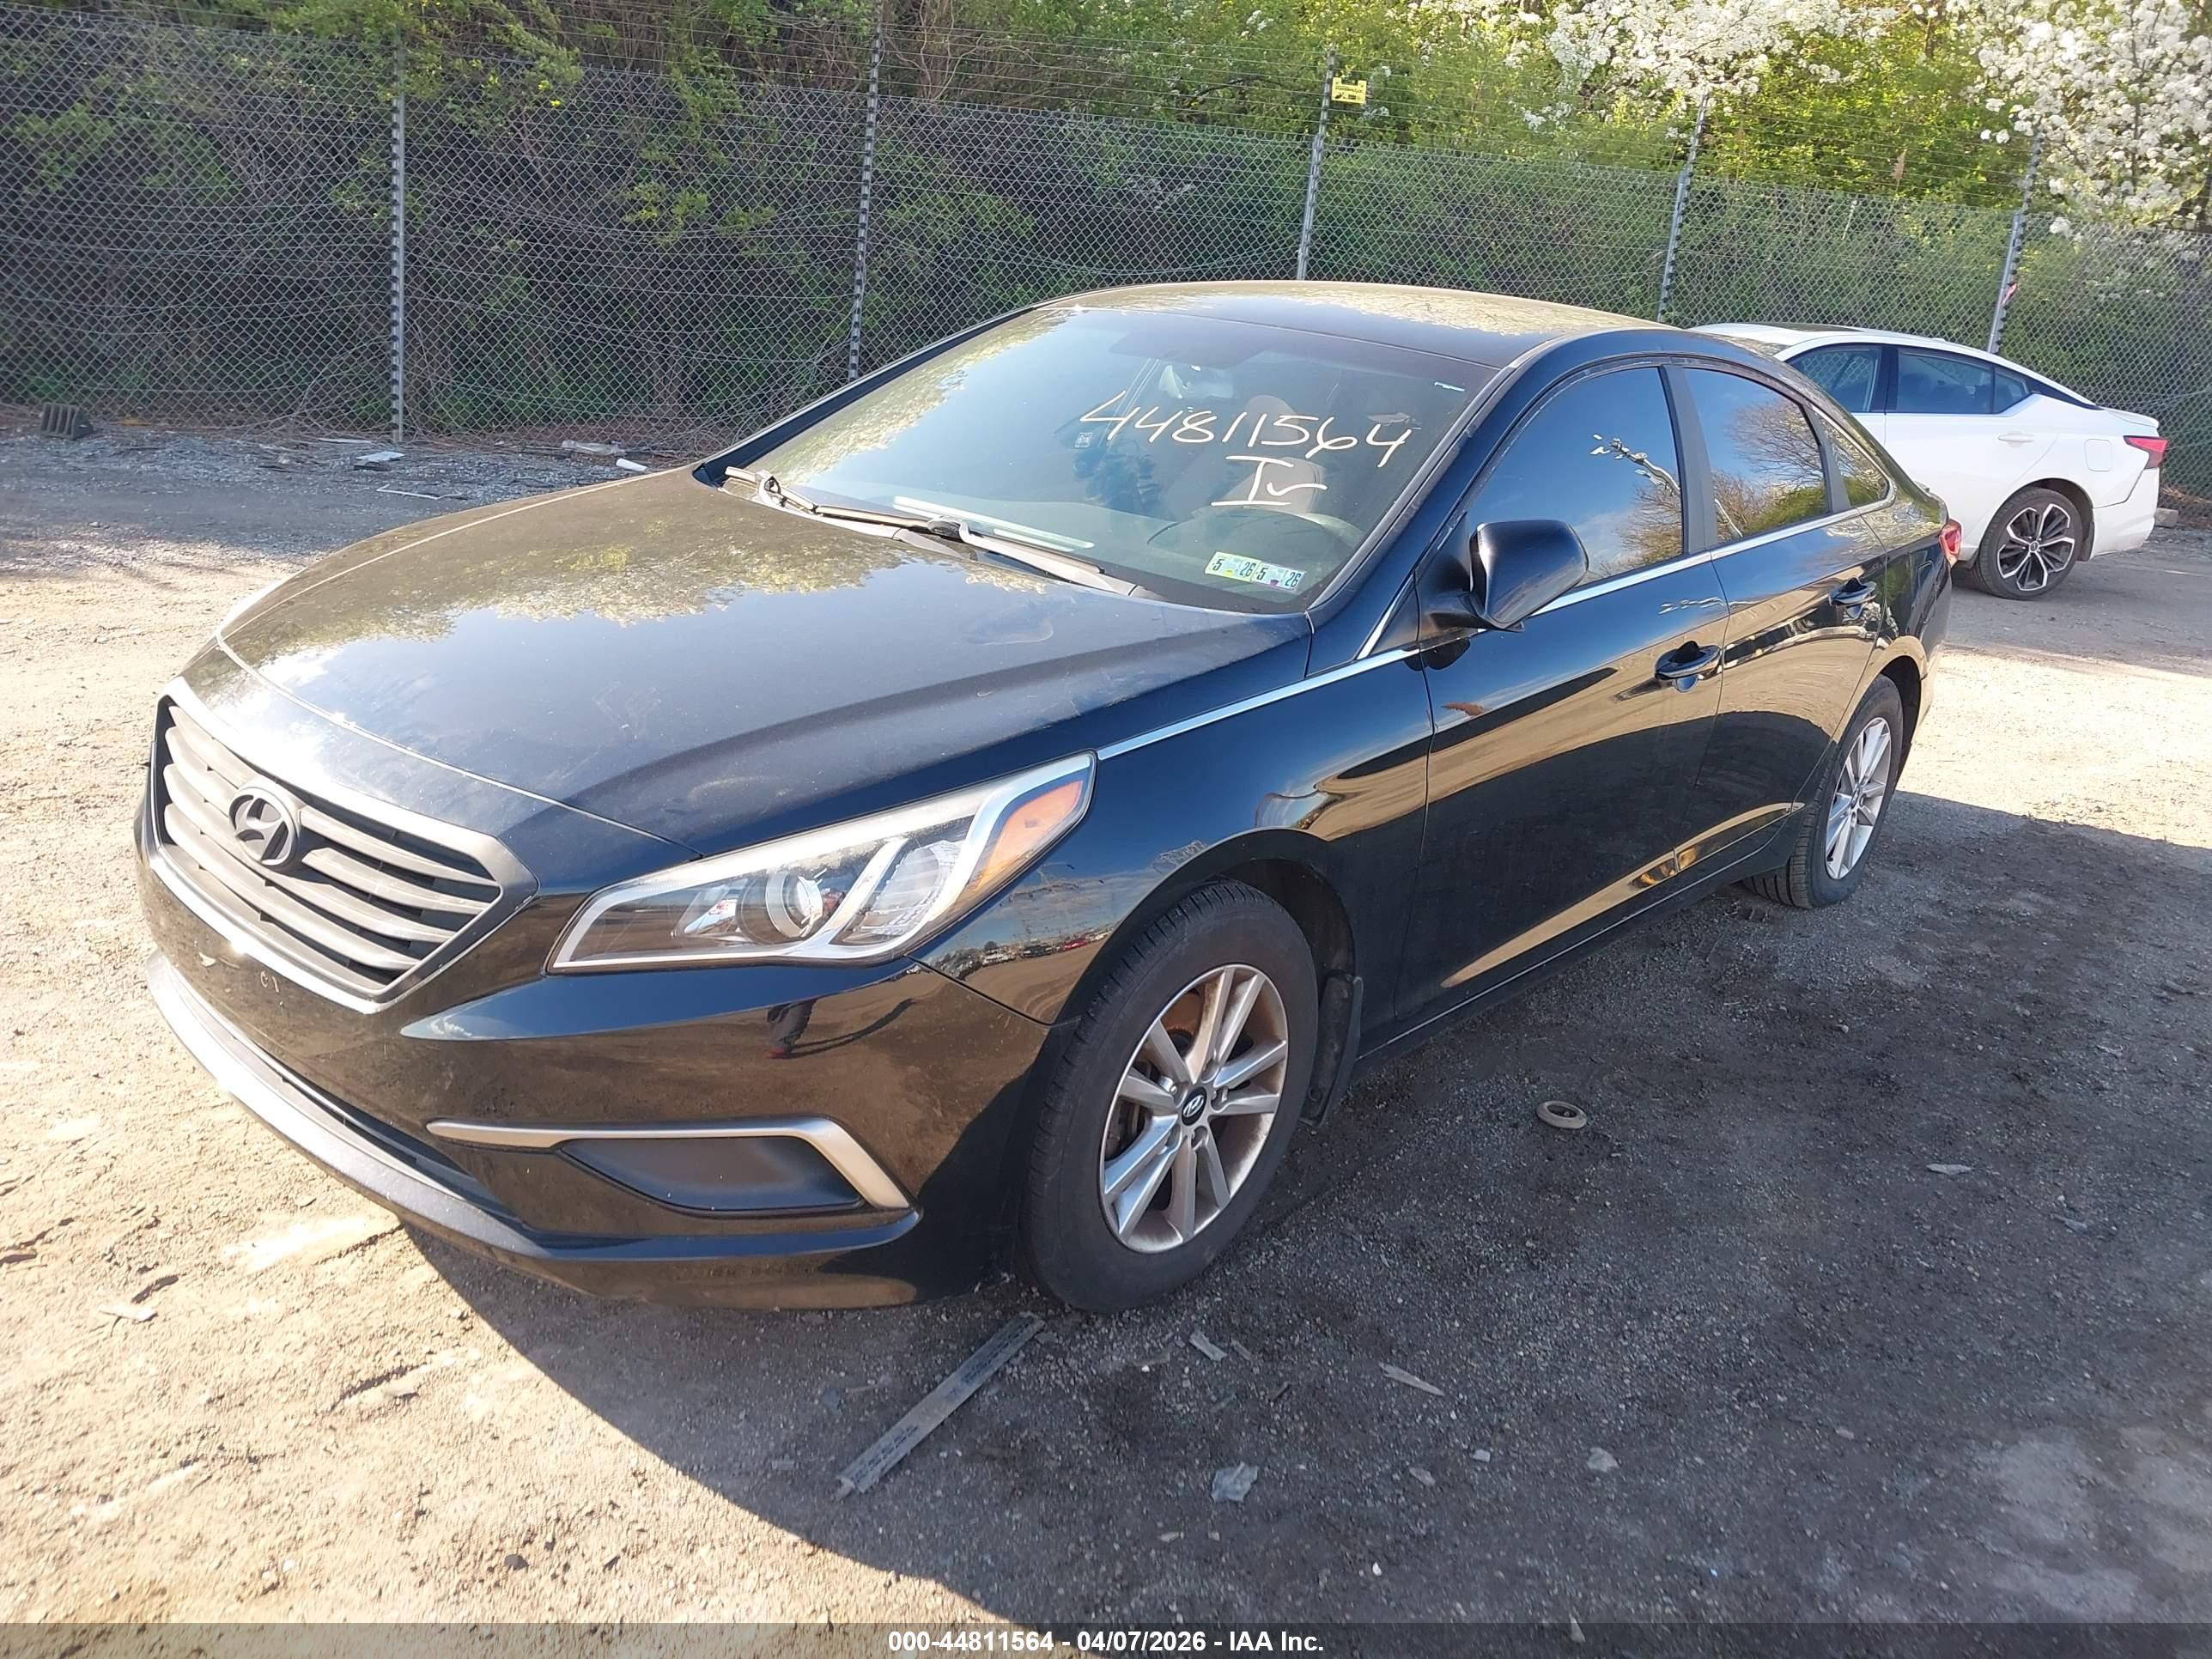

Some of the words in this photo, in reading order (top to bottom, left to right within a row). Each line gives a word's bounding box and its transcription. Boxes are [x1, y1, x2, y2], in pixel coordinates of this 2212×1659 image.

[1079, 390, 1412, 467] 44811564
[1239, 562, 1256, 577] 26
[1285, 571, 1302, 587] 26
